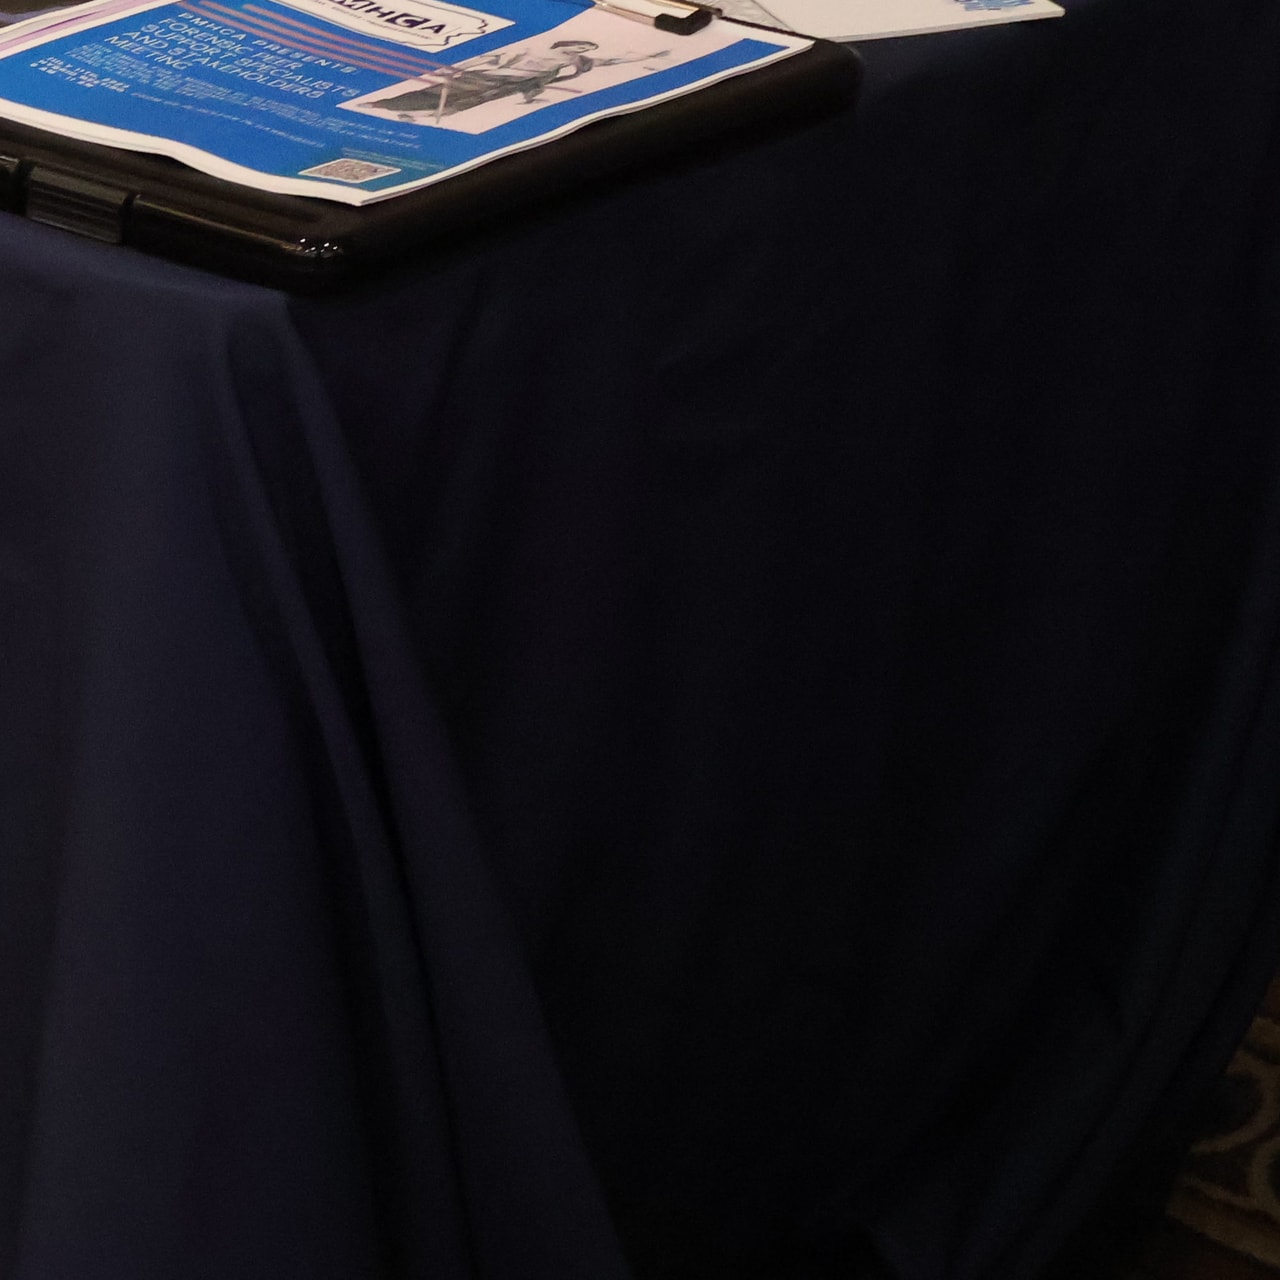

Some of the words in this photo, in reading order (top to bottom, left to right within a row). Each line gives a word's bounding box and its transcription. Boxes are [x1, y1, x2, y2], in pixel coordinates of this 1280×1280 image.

[158, 21, 253, 52] FORENSIC
[249, 53, 305, 68] PEER
[177, 14, 249, 38] PMHCA
[103, 38, 194, 67] MEETING
[117, 31, 176, 48] AND
[168, 50, 325, 95] STAKEHOLDERS
[138, 26, 234, 57] SUPPORT
[233, 60, 362, 94] SPECIALISTS
